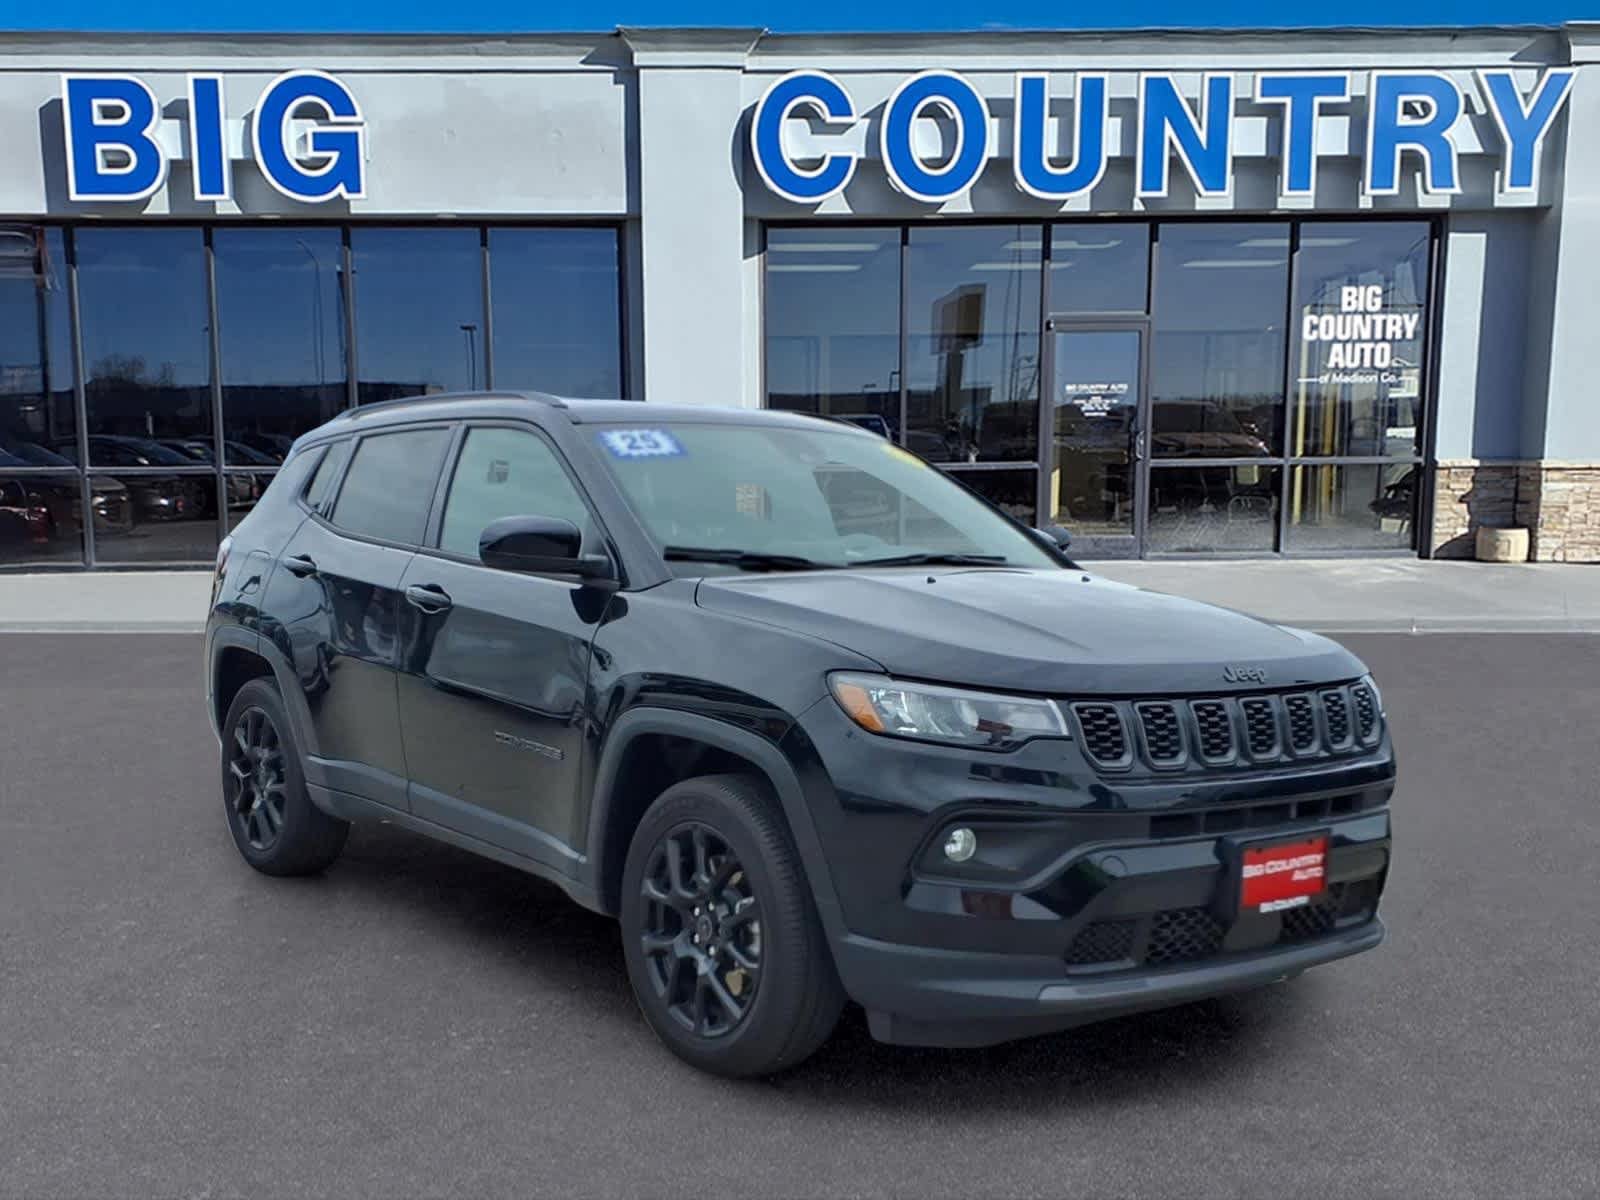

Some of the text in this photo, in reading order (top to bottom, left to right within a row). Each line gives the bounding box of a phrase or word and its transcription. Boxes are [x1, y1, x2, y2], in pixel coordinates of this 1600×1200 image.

[60, 68, 1576, 206] BIG COUNTRY
[1341, 285, 1382, 312] BIG
[1303, 313, 1420, 340] COUNTRY
[1327, 342, 1391, 369] AUTO
[1331, 372, 1378, 384] Madison
[1223, 666, 1266, 685] Jeep
